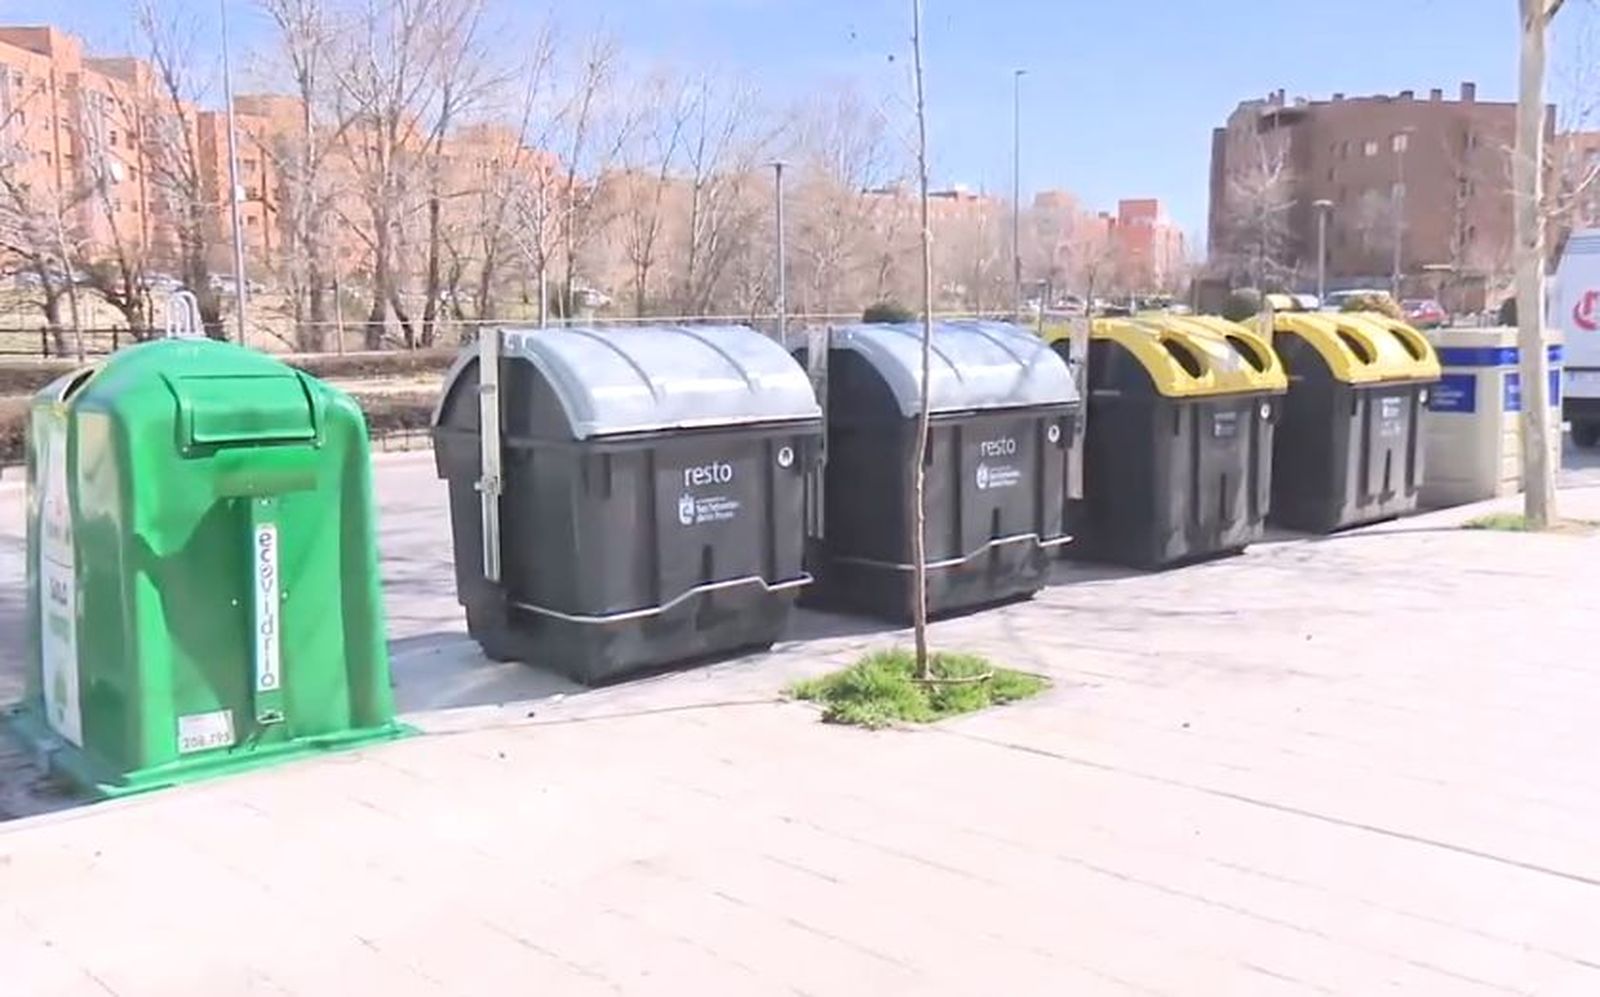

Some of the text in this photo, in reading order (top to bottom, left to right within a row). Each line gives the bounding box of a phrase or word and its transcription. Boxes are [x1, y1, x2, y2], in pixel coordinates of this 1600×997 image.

[981, 436, 1016, 456] resto
[684, 461, 732, 487] resto
[258, 531, 276, 688] ecovidrio
